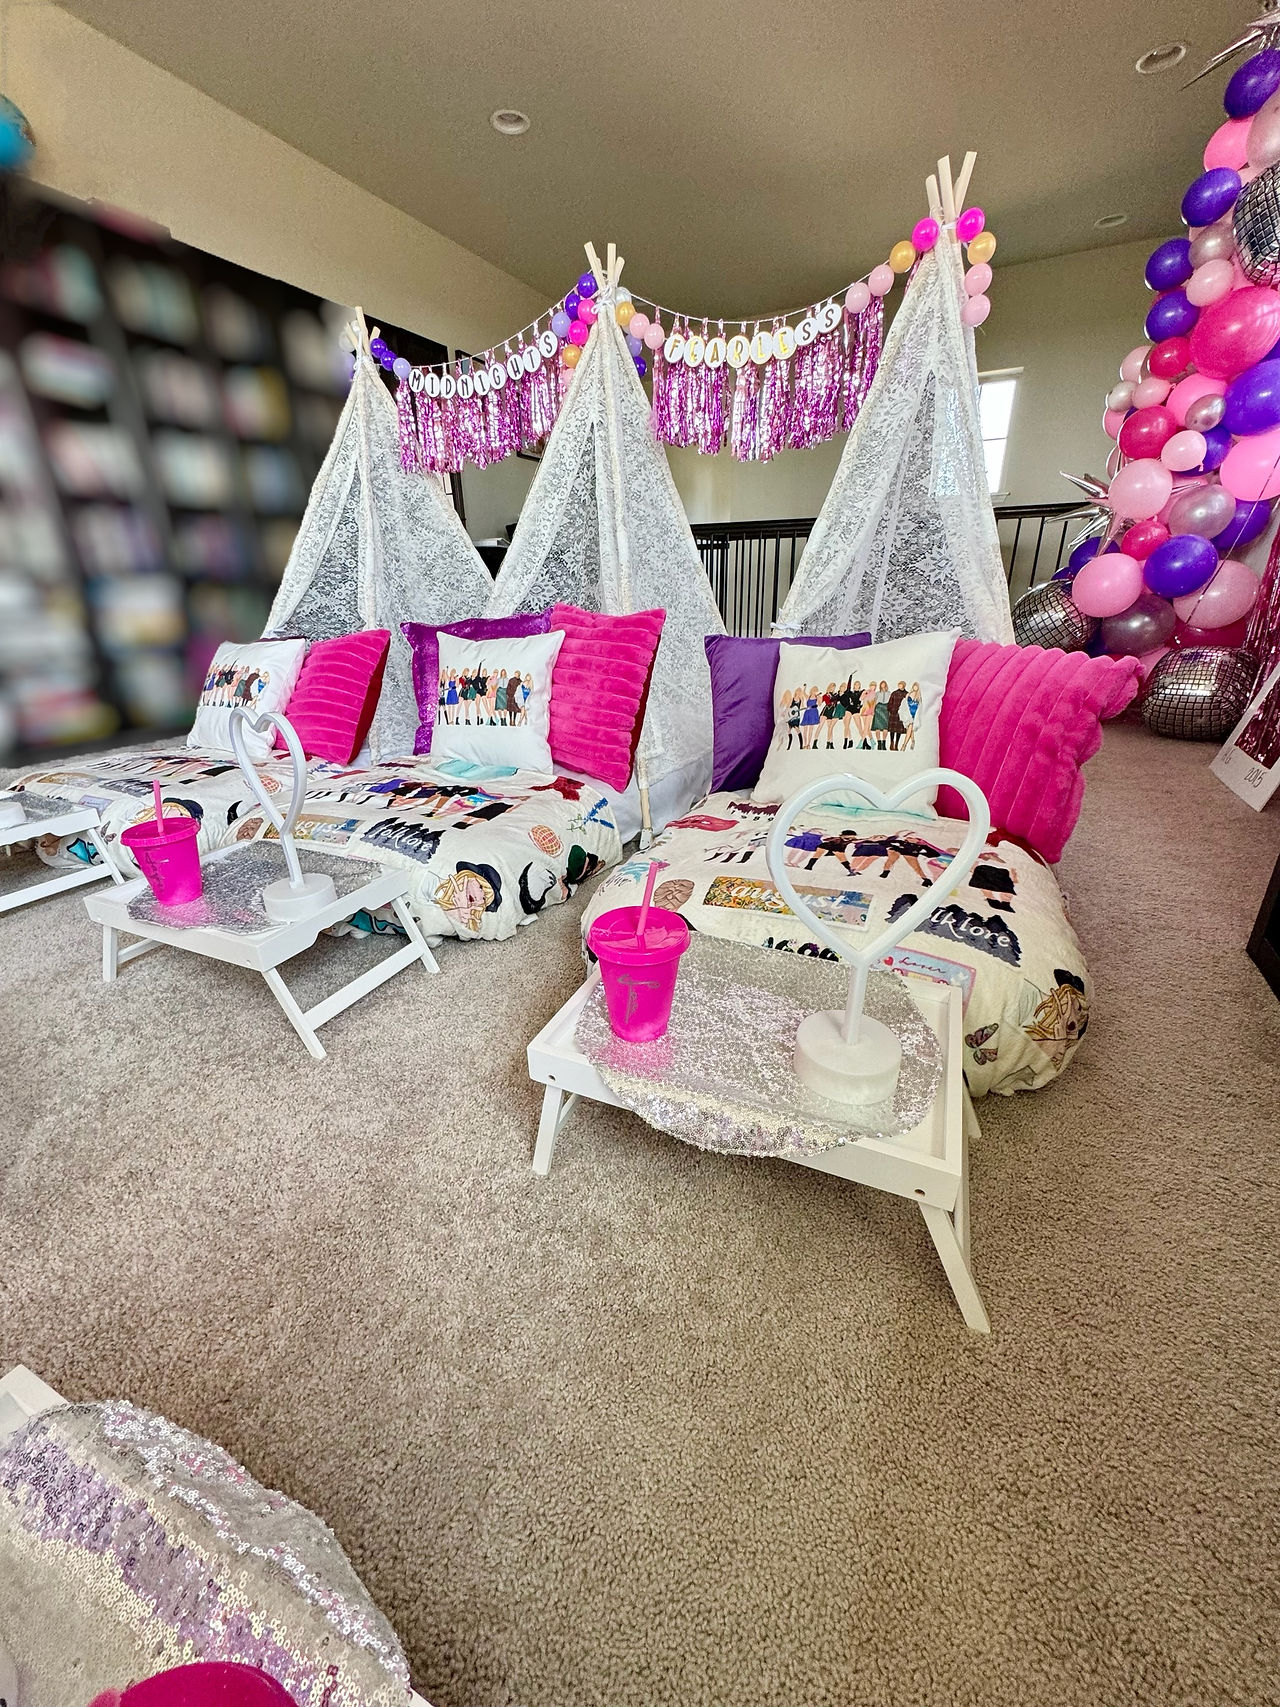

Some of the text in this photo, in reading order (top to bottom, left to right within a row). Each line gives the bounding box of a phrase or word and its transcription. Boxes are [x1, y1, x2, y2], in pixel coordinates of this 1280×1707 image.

[671, 308, 834, 367] FEARLESS
[411, 334, 554, 394] MIDNIGHTS
[368, 823, 433, 852] folklore
[929, 909, 1011, 947] lklore
